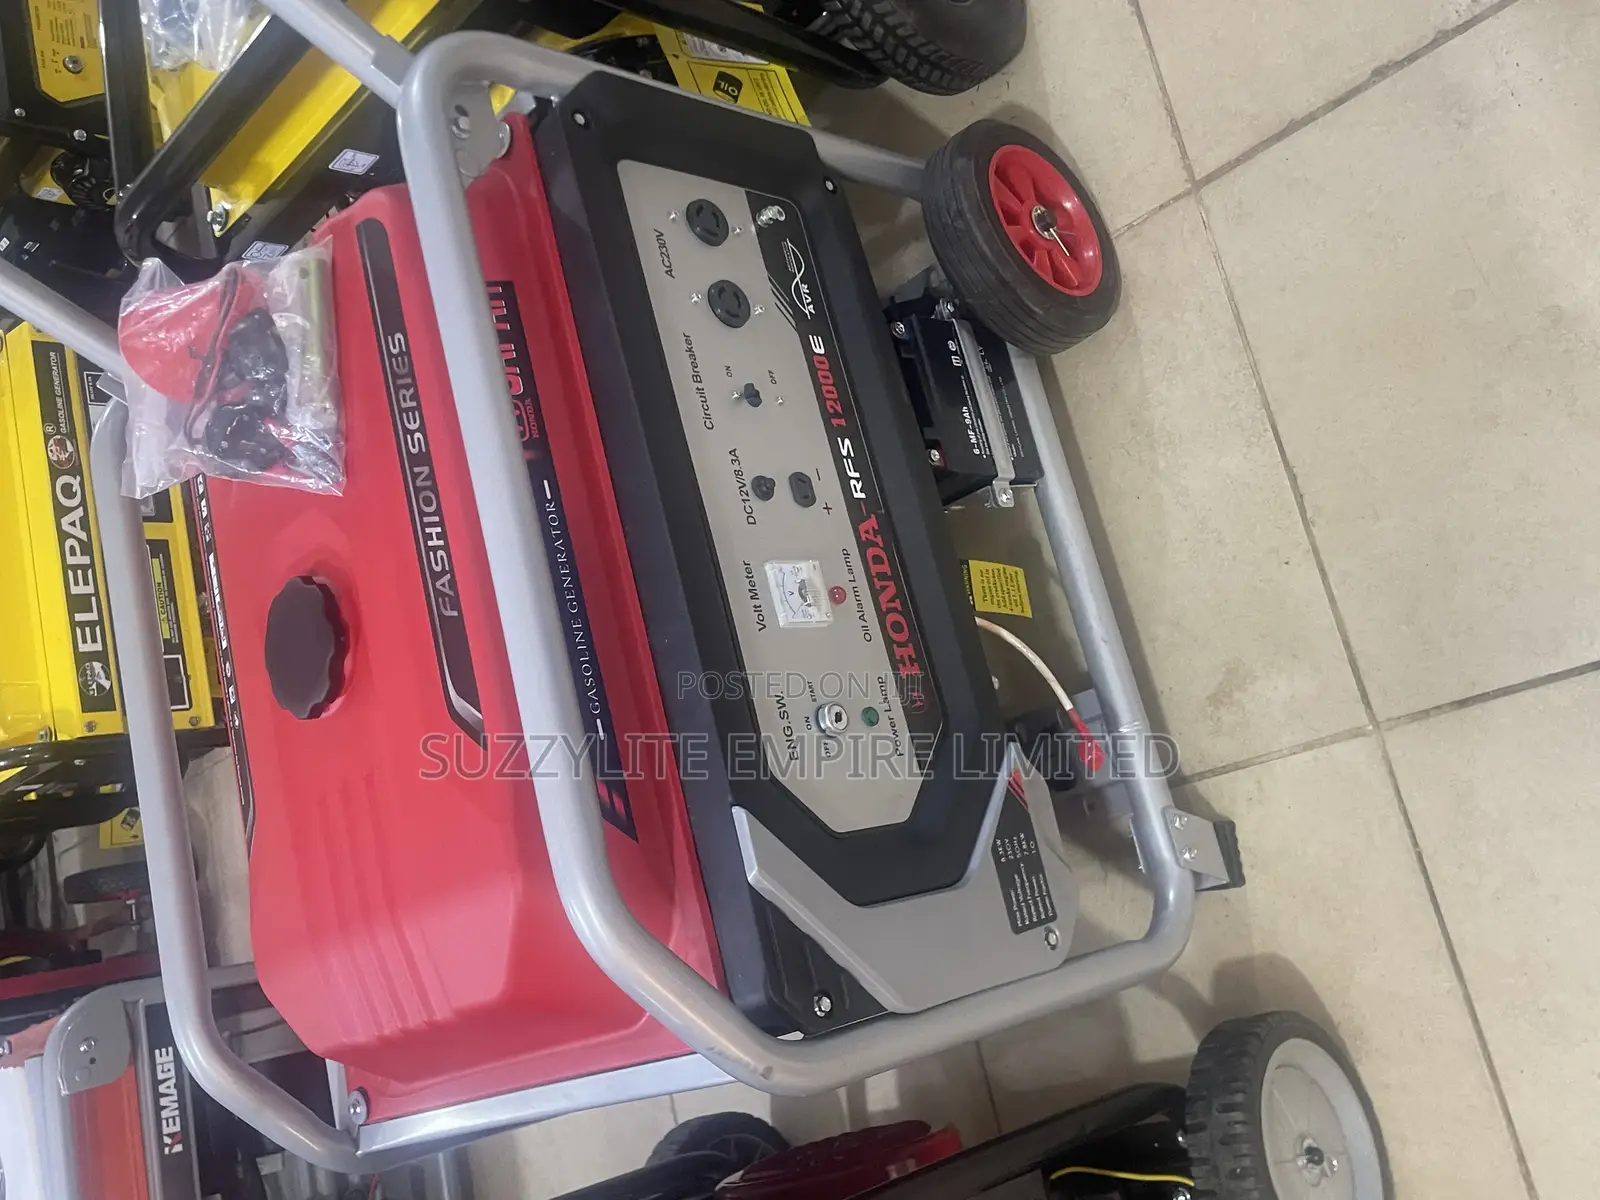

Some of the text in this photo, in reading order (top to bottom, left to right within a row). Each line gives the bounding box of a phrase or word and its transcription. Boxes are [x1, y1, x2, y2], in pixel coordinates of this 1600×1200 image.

[717, 80, 738, 96] OIL
[653, 228, 675, 279] AC230V
[802, 283, 816, 314] AVR
[50, 351, 67, 434] GASOLINE GENERATOR
[682, 332, 715, 430] Circuit Breaker
[724, 365, 733, 378] ON
[768, 370, 778, 384] OFF
[808, 334, 848, 428] 12000E
[524, 397, 540, 438] HONDA
[962, 406, 980, 454] 6-MF-9Ah
[387, 332, 458, 616] FASHION SERIES
[728, 448, 757, 525] DC12V/8.3A
[56, 475, 103, 652] ELEPAQ
[156, 582, 166, 615] CAUTION
[742, 560, 767, 632] Volt Meter
[841, 548, 872, 642] Oil Alarm Lamp
[544, 500, 601, 714] GASOLINE GENERATOR
[774, 690, 799, 760] ENG.SW.
[804, 716, 812, 730] ON
[806, 680, 818, 702] START
[876, 676, 904, 756] Power Lamp
[823, 740, 831, 758] OFF
[154, 1046, 184, 1155] KEMAGE
